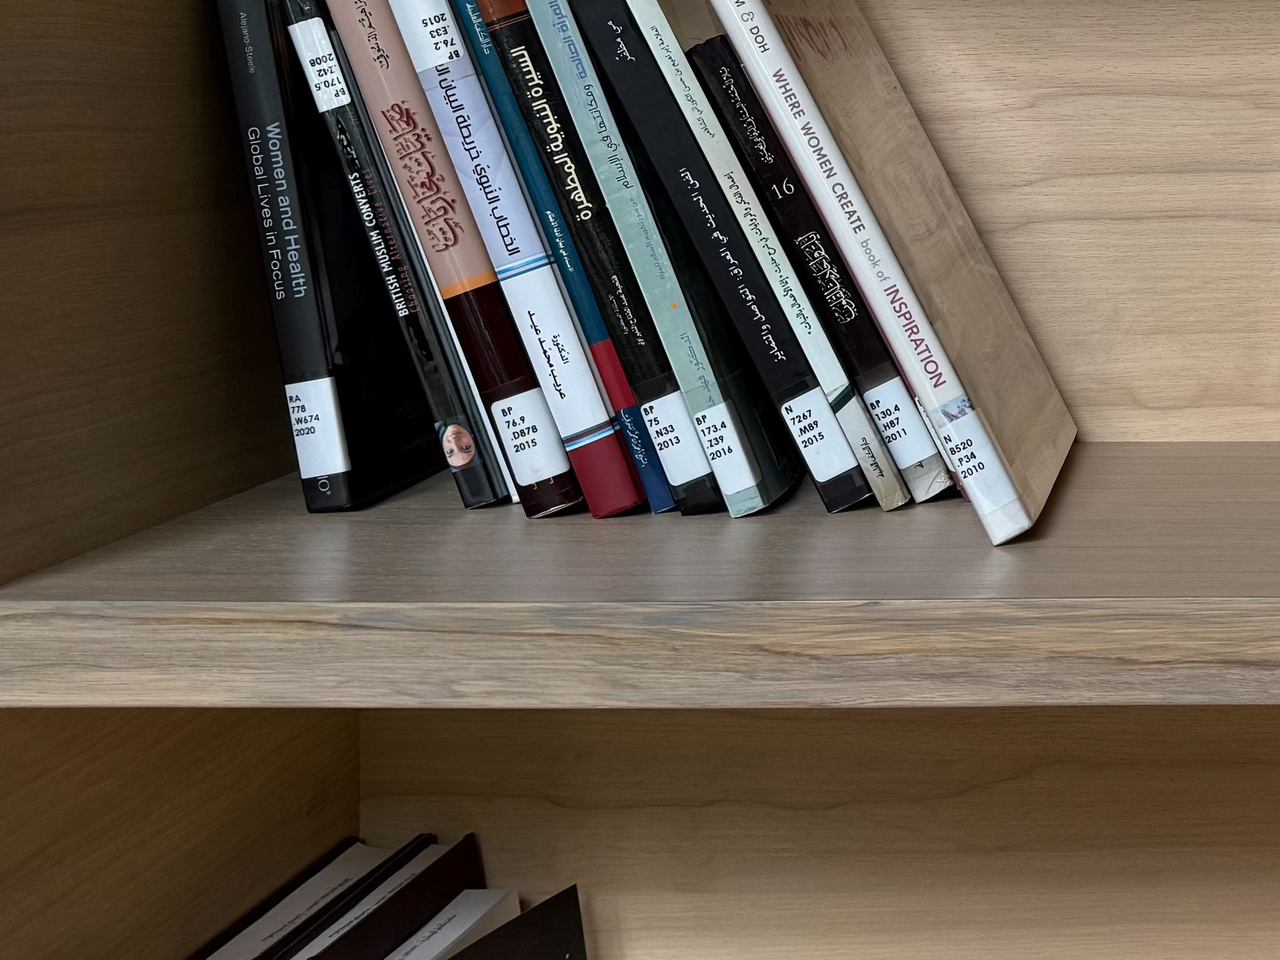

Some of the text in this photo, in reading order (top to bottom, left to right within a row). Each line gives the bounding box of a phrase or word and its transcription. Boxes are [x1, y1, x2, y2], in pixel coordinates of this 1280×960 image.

[422, 12, 447, 27] 2015
[739, 8, 756, 25] &
[433, 38, 457, 51] 76.2
[748, 24, 770, 54] DOH
[309, 53, 334, 67] 2008
[448, 50, 460, 61] BP
[314, 77, 342, 91] 170.5
[334, 88, 346, 98] BP
[562, 34, 620, 154] الصالحة ومكانتها في
[770, 67, 806, 120] WHERE
[511, 43, 595, 223] السيرة النبوية المطهرة
[801, 120, 838, 180] WOMEN
[437, 76, 521, 256] الخطاب خريطة البيان
[771, 179, 794, 199] 16
[245, 126, 288, 300] Global Lives in Focus
[265, 121, 308, 298] Women and Health
[830, 180, 866, 235] CREATE
[345, 170, 411, 317] BRITISH MUSLIM CONVERTS
[859, 237, 883, 270] book
[678, 164, 787, 365] الفن الحديث في التواصل والتمايز
[874, 267, 891, 284] of
[882, 282, 947, 389] INSPIRATION
[289, 395, 301, 403] RA
[869, 400, 881, 411] BP
[291, 404, 306, 414] 778
[501, 406, 513, 418] BP
[643, 405, 654, 416] BP
[784, 405, 793, 415] N
[875, 404, 900, 421] 130.4
[293, 414, 320, 426] .W674
[504, 415, 526, 429] 76.9
[647, 417, 660, 428] 75
[695, 415, 707, 426] BP
[790, 409, 813, 426] 7267
[881, 417, 900, 432] .H87
[294, 426, 316, 437] 2020
[510, 425, 538, 442] .D878
[653, 424, 675, 440] .N33
[701, 421, 727, 437] 173.4
[798, 420, 819, 437] .M89
[886, 428, 907, 444] 2011
[513, 438, 537, 453] 2015
[657, 436, 681, 451] 2013
[706, 435, 724, 449] .Z39
[802, 433, 825, 449] 2015
[943, 434, 952, 444] N
[949, 438, 973, 456] 8520
[709, 446, 733, 461] 2016
[957, 451, 976, 468] .P34
[961, 462, 985, 479] 2010
